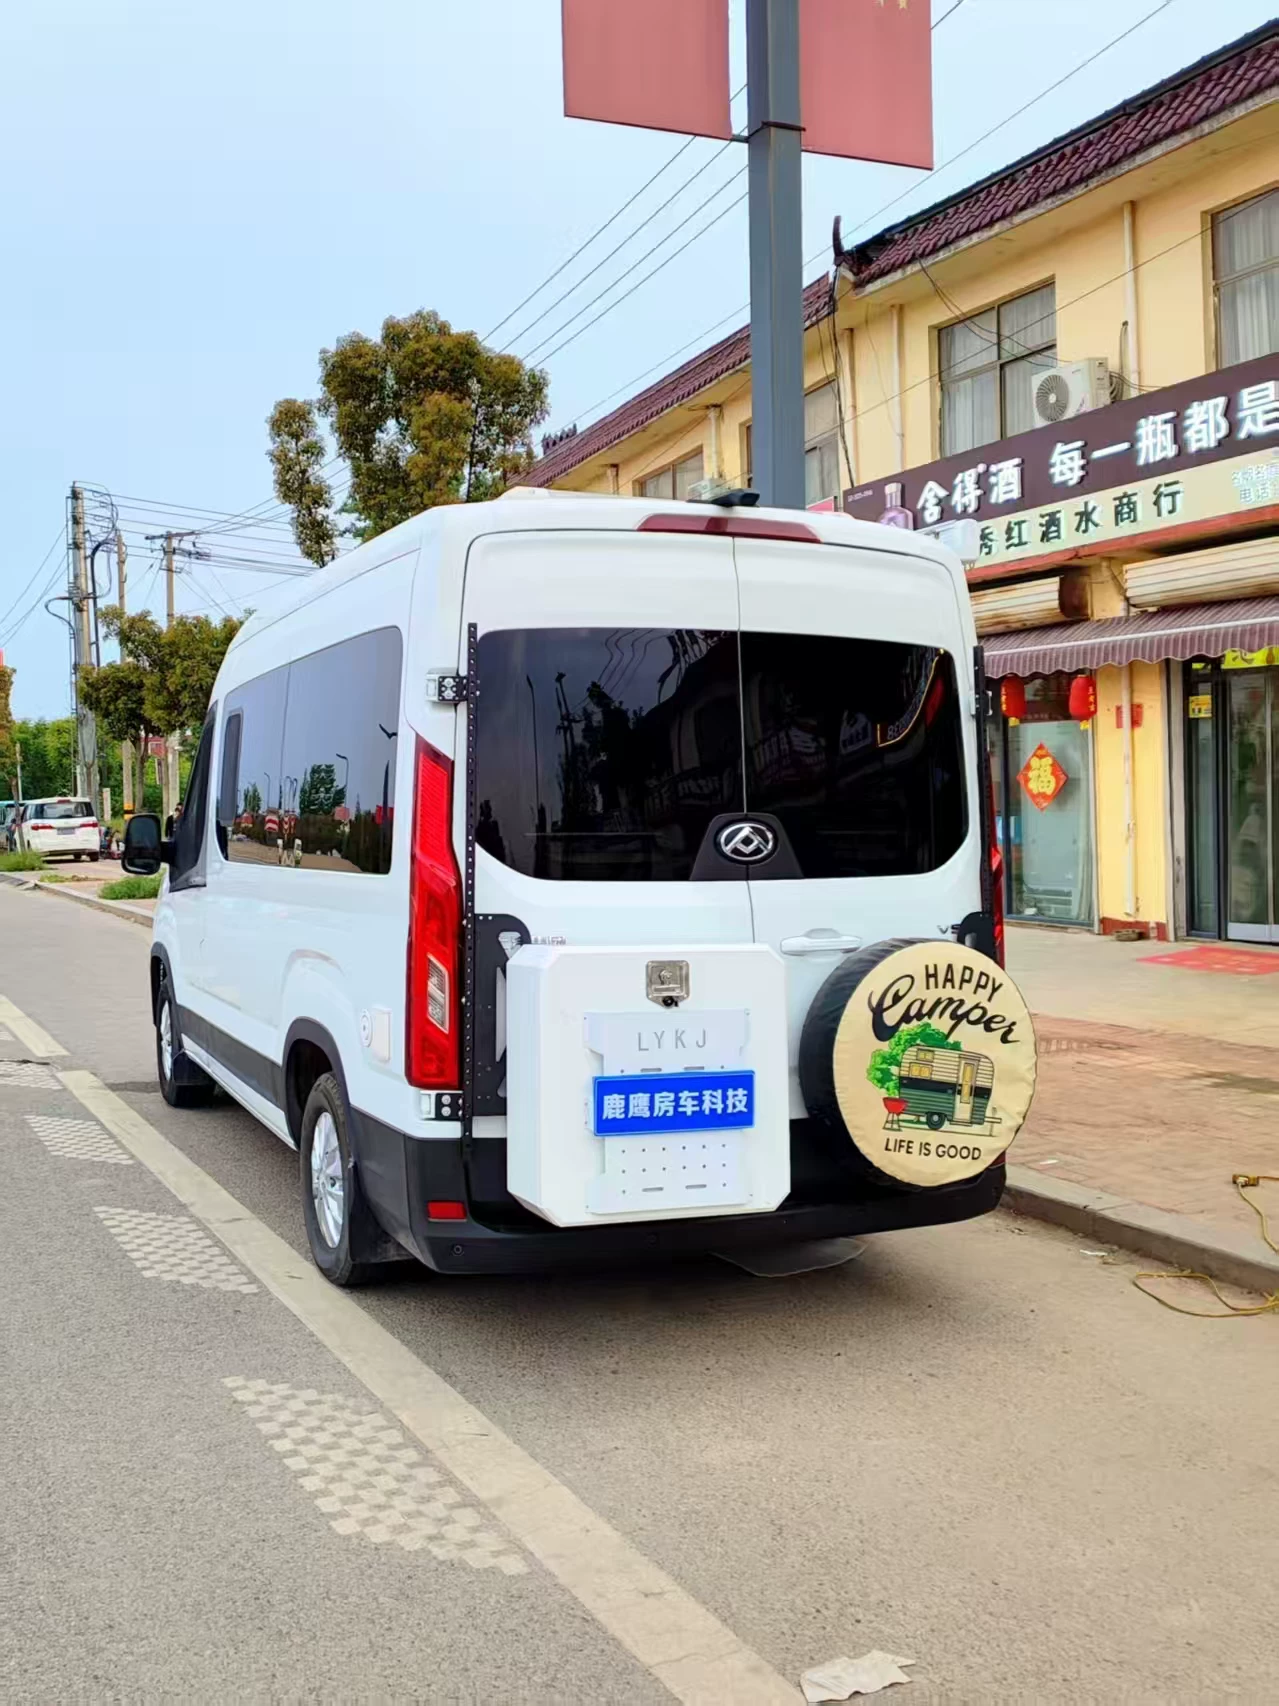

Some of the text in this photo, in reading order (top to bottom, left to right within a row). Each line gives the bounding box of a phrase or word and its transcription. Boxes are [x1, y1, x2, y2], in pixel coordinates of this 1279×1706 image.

[916, 380, 1279, 525] 舍得酒 每一瓶都是
[924, 963, 1004, 1003] HAPPY
[867, 974, 1021, 1045] Camper
[637, 1028, 707, 1052] LYKJ
[602, 1087, 748, 1120] 鹿鹰房车科技
[884, 1137, 982, 1161] LIFE IS GOOD
